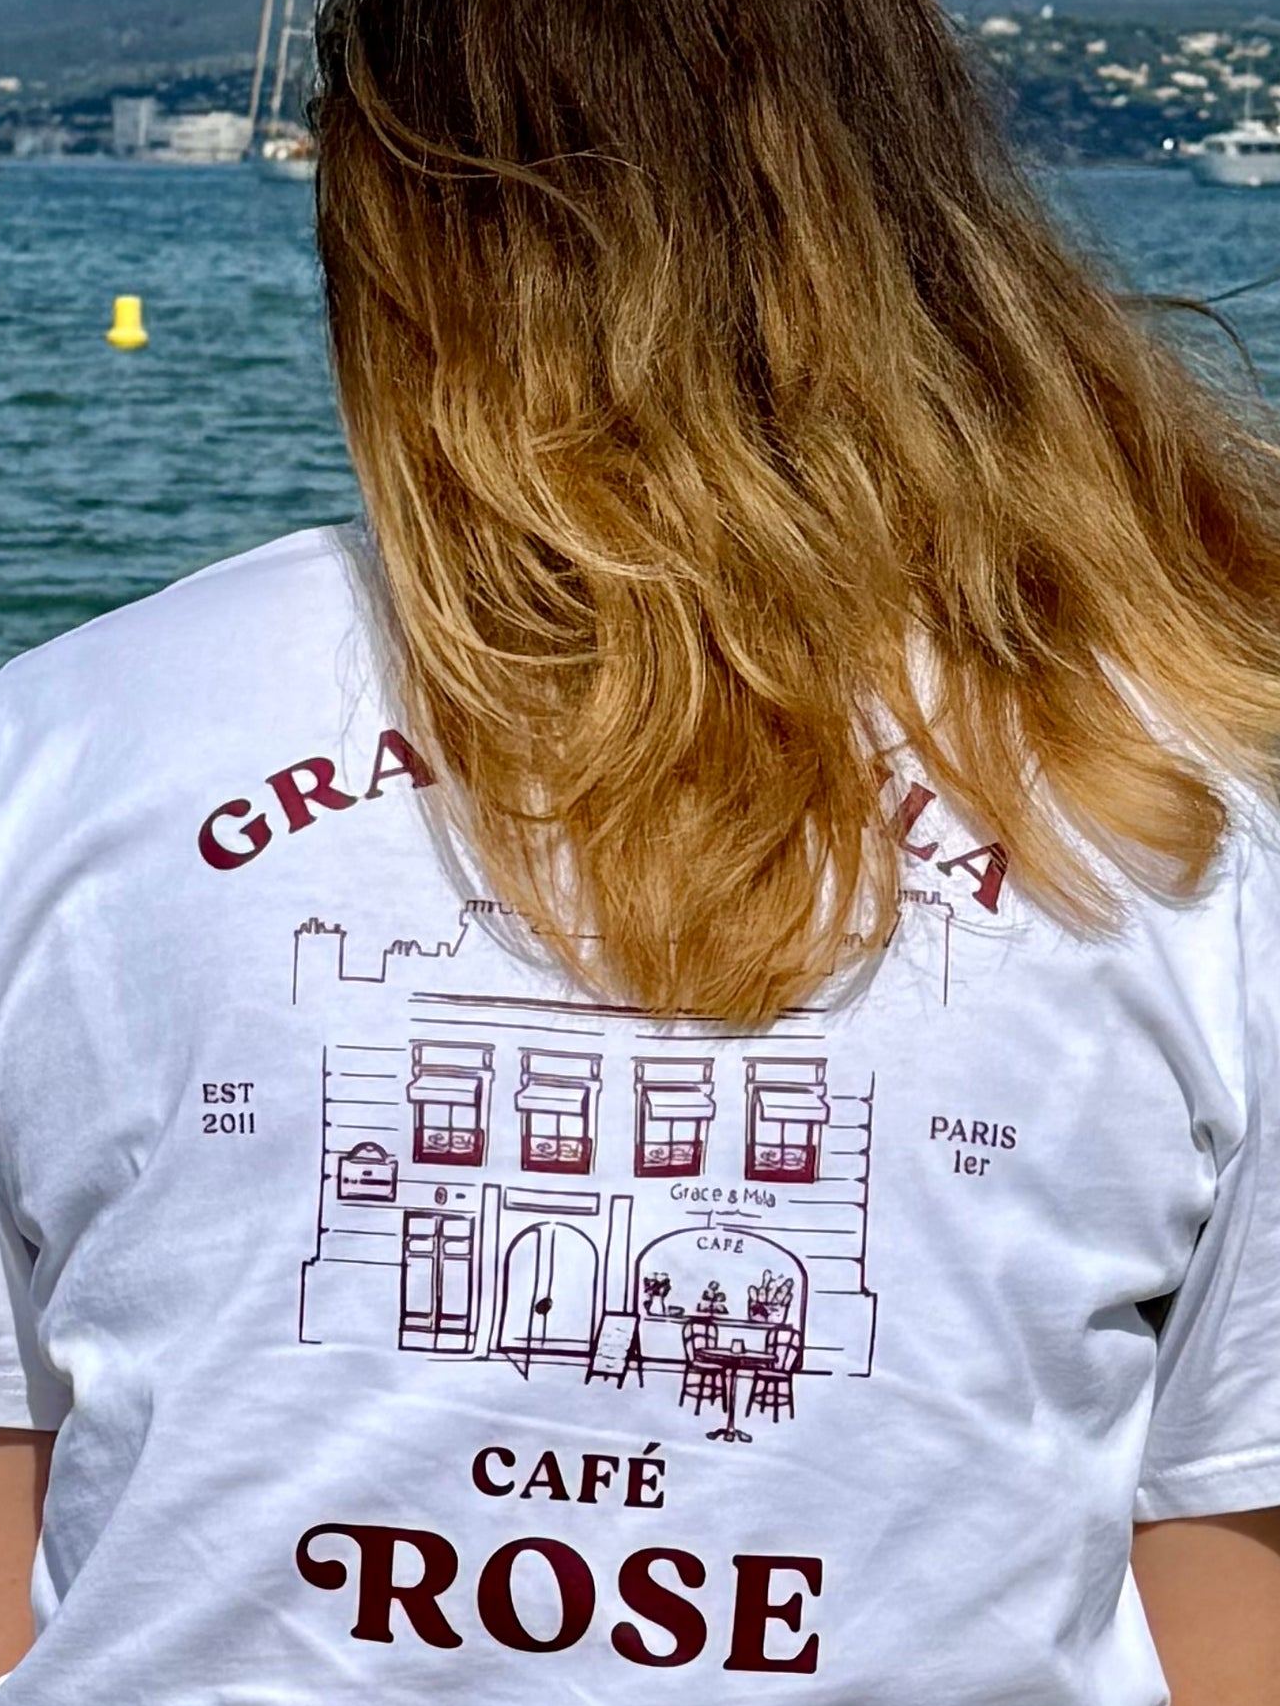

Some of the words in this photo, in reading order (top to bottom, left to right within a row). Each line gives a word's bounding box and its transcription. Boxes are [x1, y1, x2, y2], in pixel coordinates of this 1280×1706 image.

[198, 729, 438, 870] GRA
[202, 1082, 255, 1104] EST
[202, 1112, 256, 1135] 2011
[929, 1116, 1017, 1150] PARIS
[670, 1183, 723, 1202] Grace
[471, 1441, 666, 1509] CAFÉ
[295, 1522, 823, 1675] ROSE
